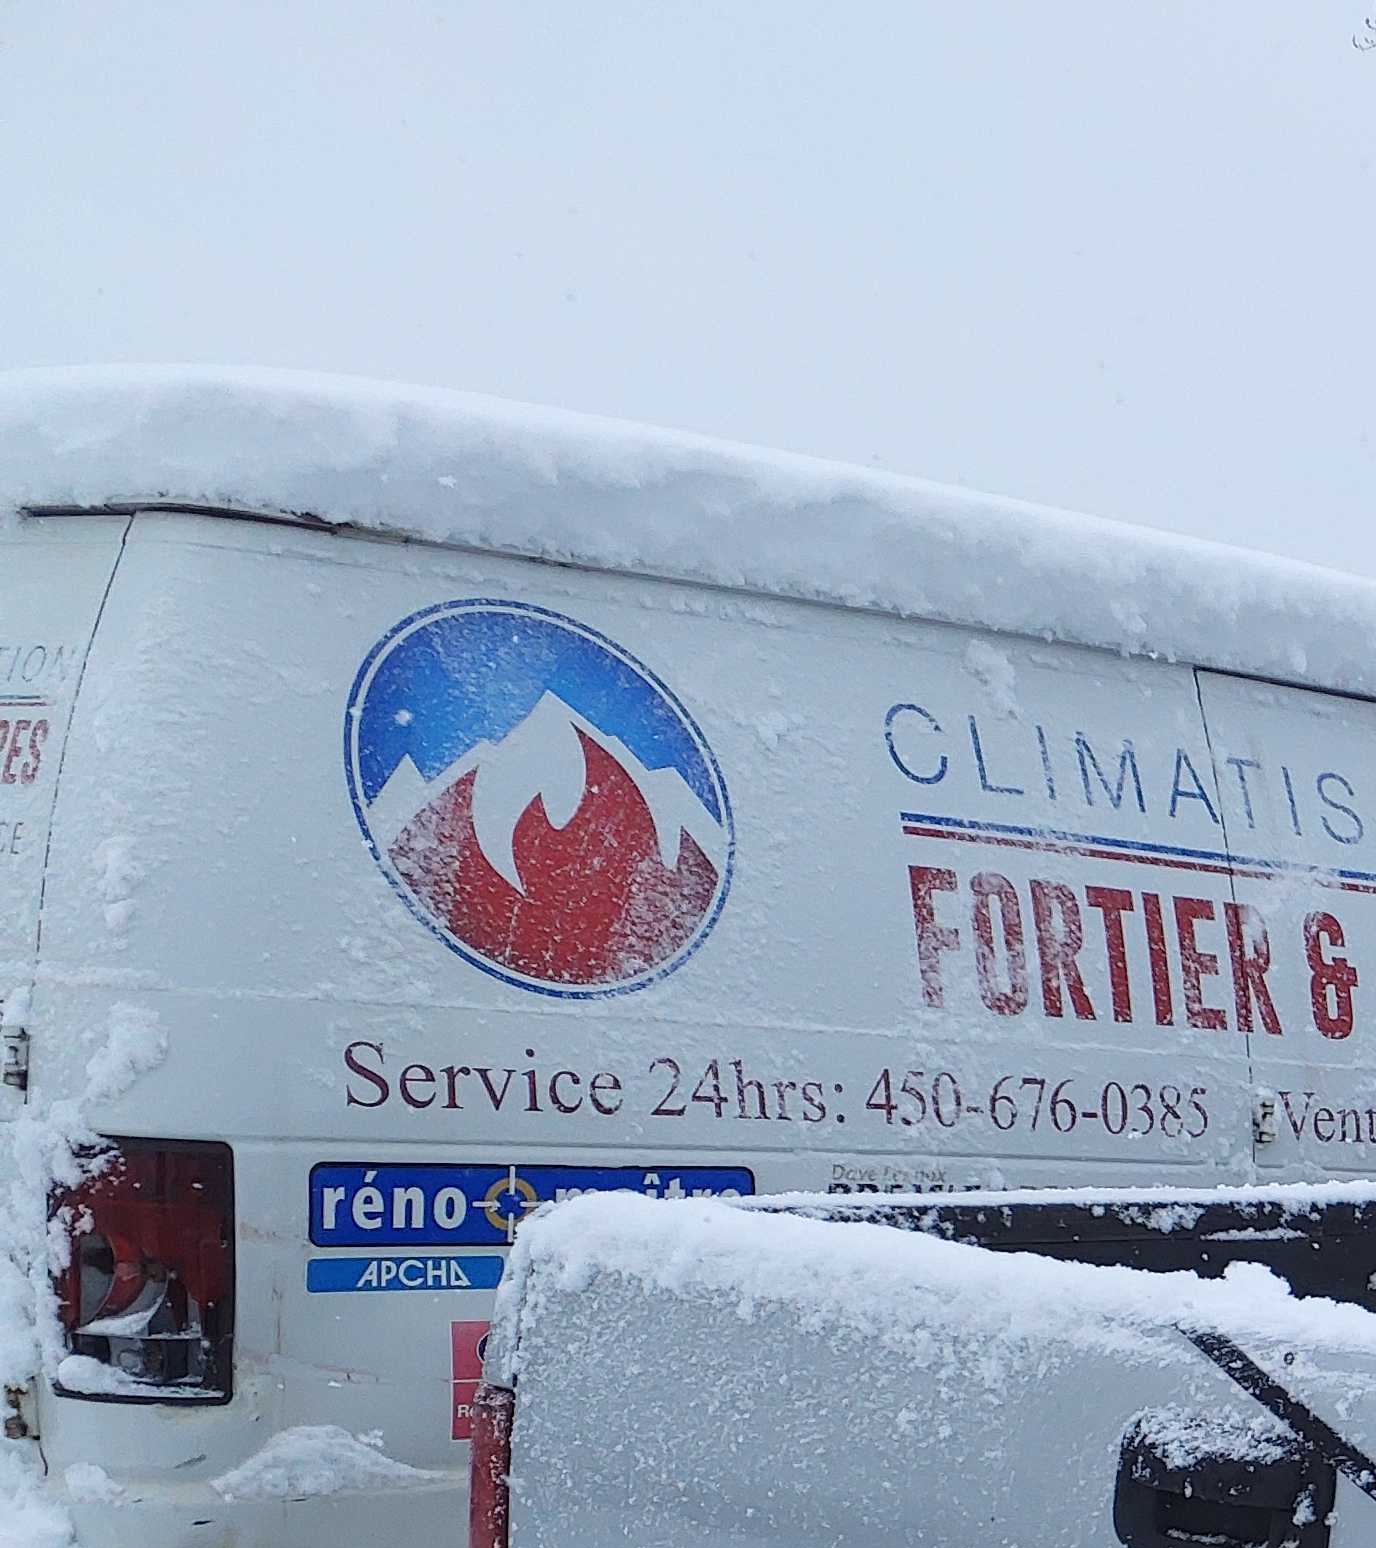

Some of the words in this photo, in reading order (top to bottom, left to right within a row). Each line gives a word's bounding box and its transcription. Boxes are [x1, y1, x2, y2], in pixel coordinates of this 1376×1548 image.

[907, 864, 1284, 1036] FORTIER
[1304, 911, 1358, 1039] &
[344, 1041, 624, 1115] Service
[649, 1057, 846, 1124] 24hrs:
[866, 1068, 1208, 1138] 450-676-0385
